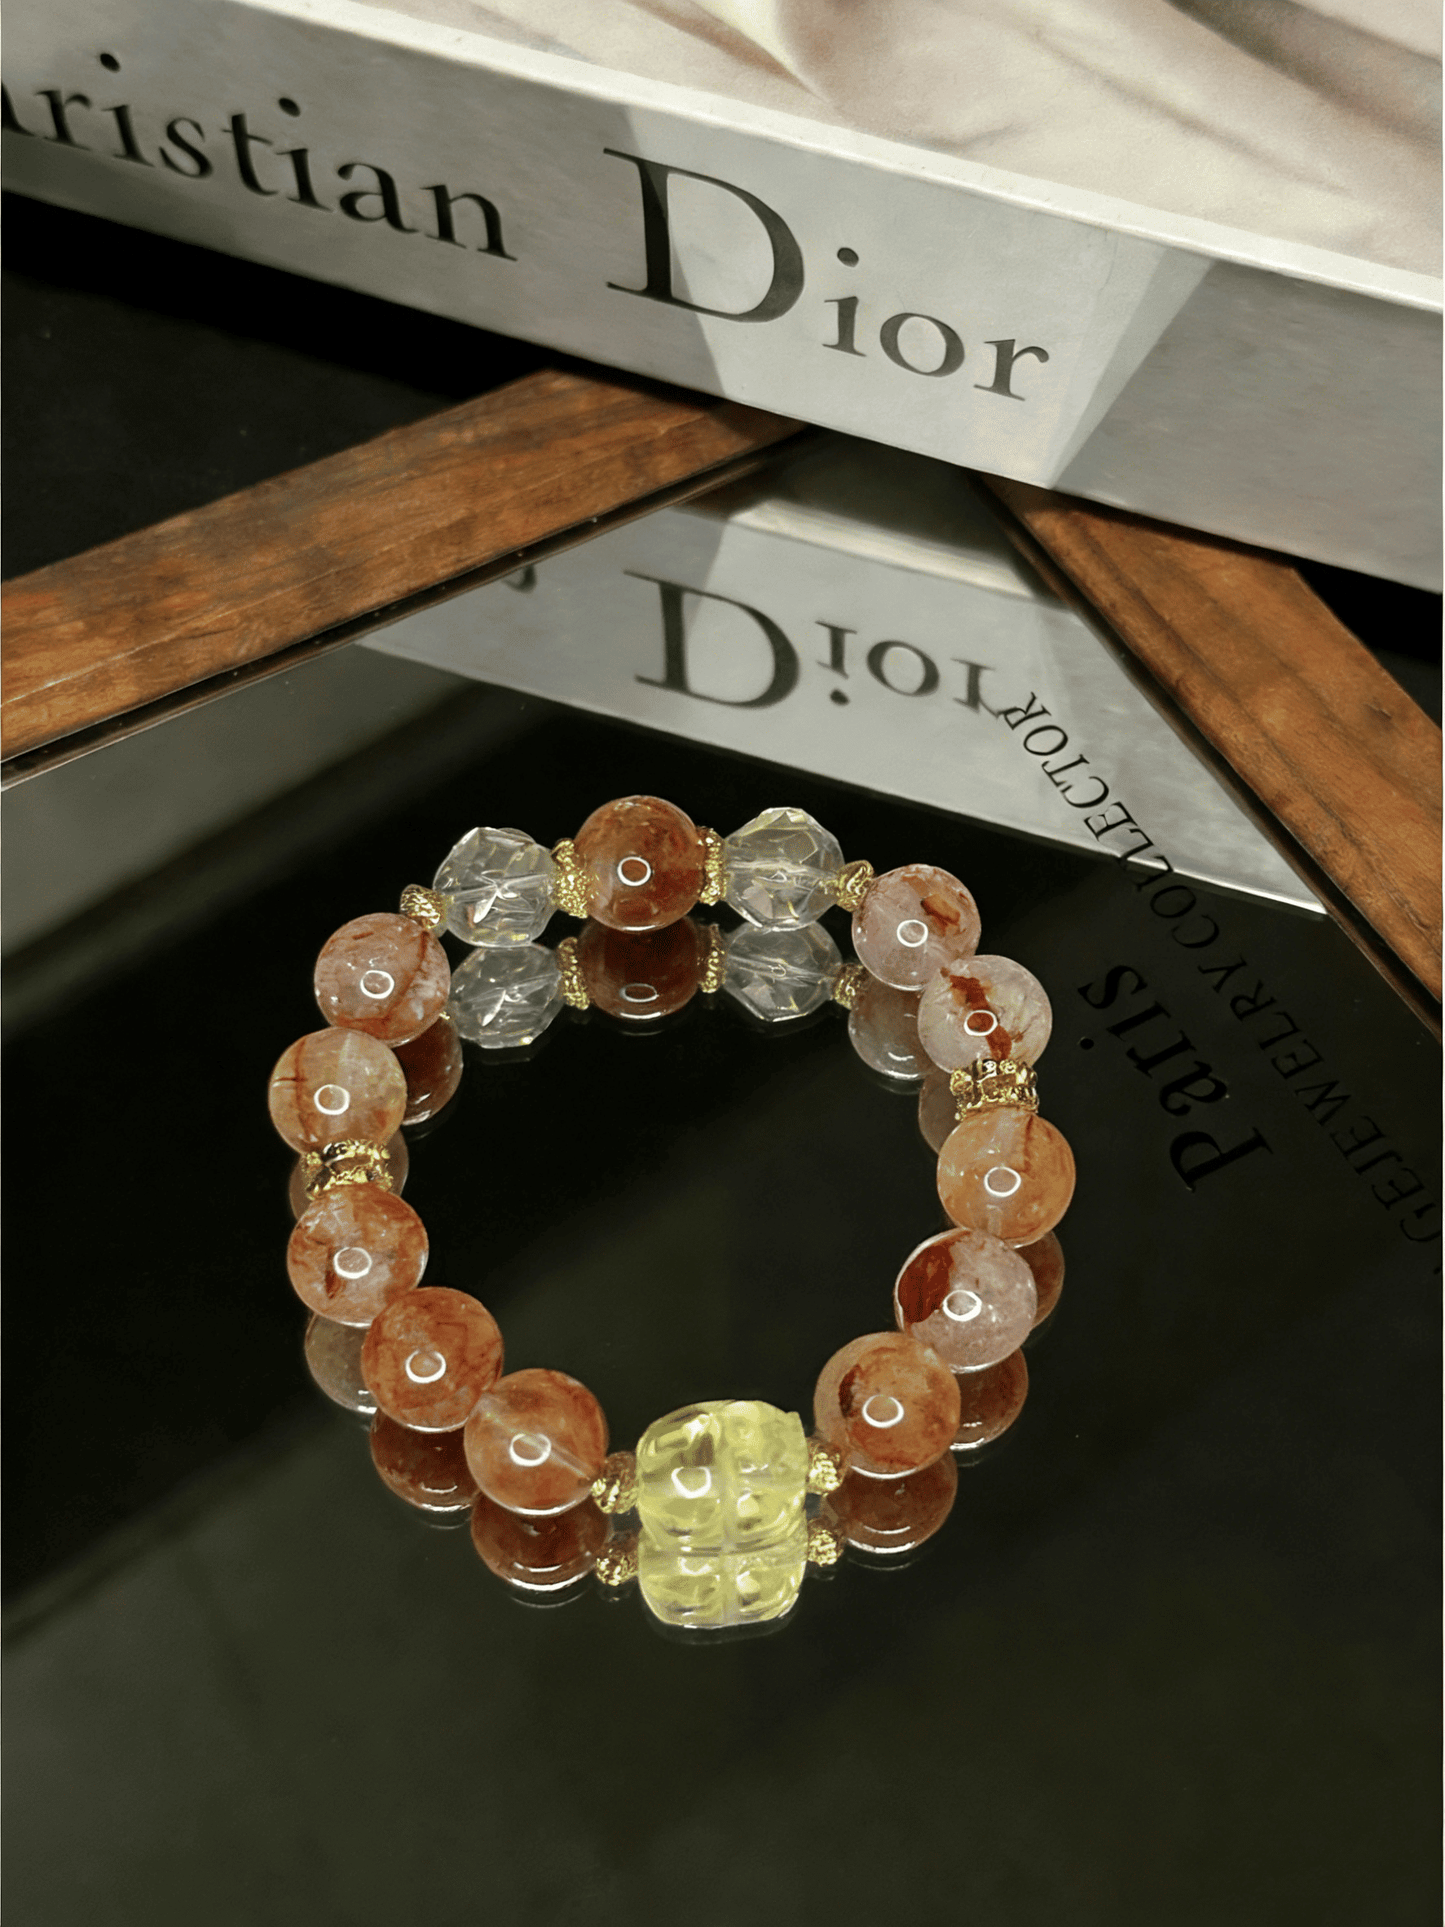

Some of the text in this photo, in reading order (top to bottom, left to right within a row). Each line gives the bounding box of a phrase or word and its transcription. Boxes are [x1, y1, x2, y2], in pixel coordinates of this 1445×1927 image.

[603, 147, 1050, 401] Dior
[999, 692, 1443, 1275] GEJEWELRY COLLECTOR
[1077, 964, 1274, 1193] Paris
